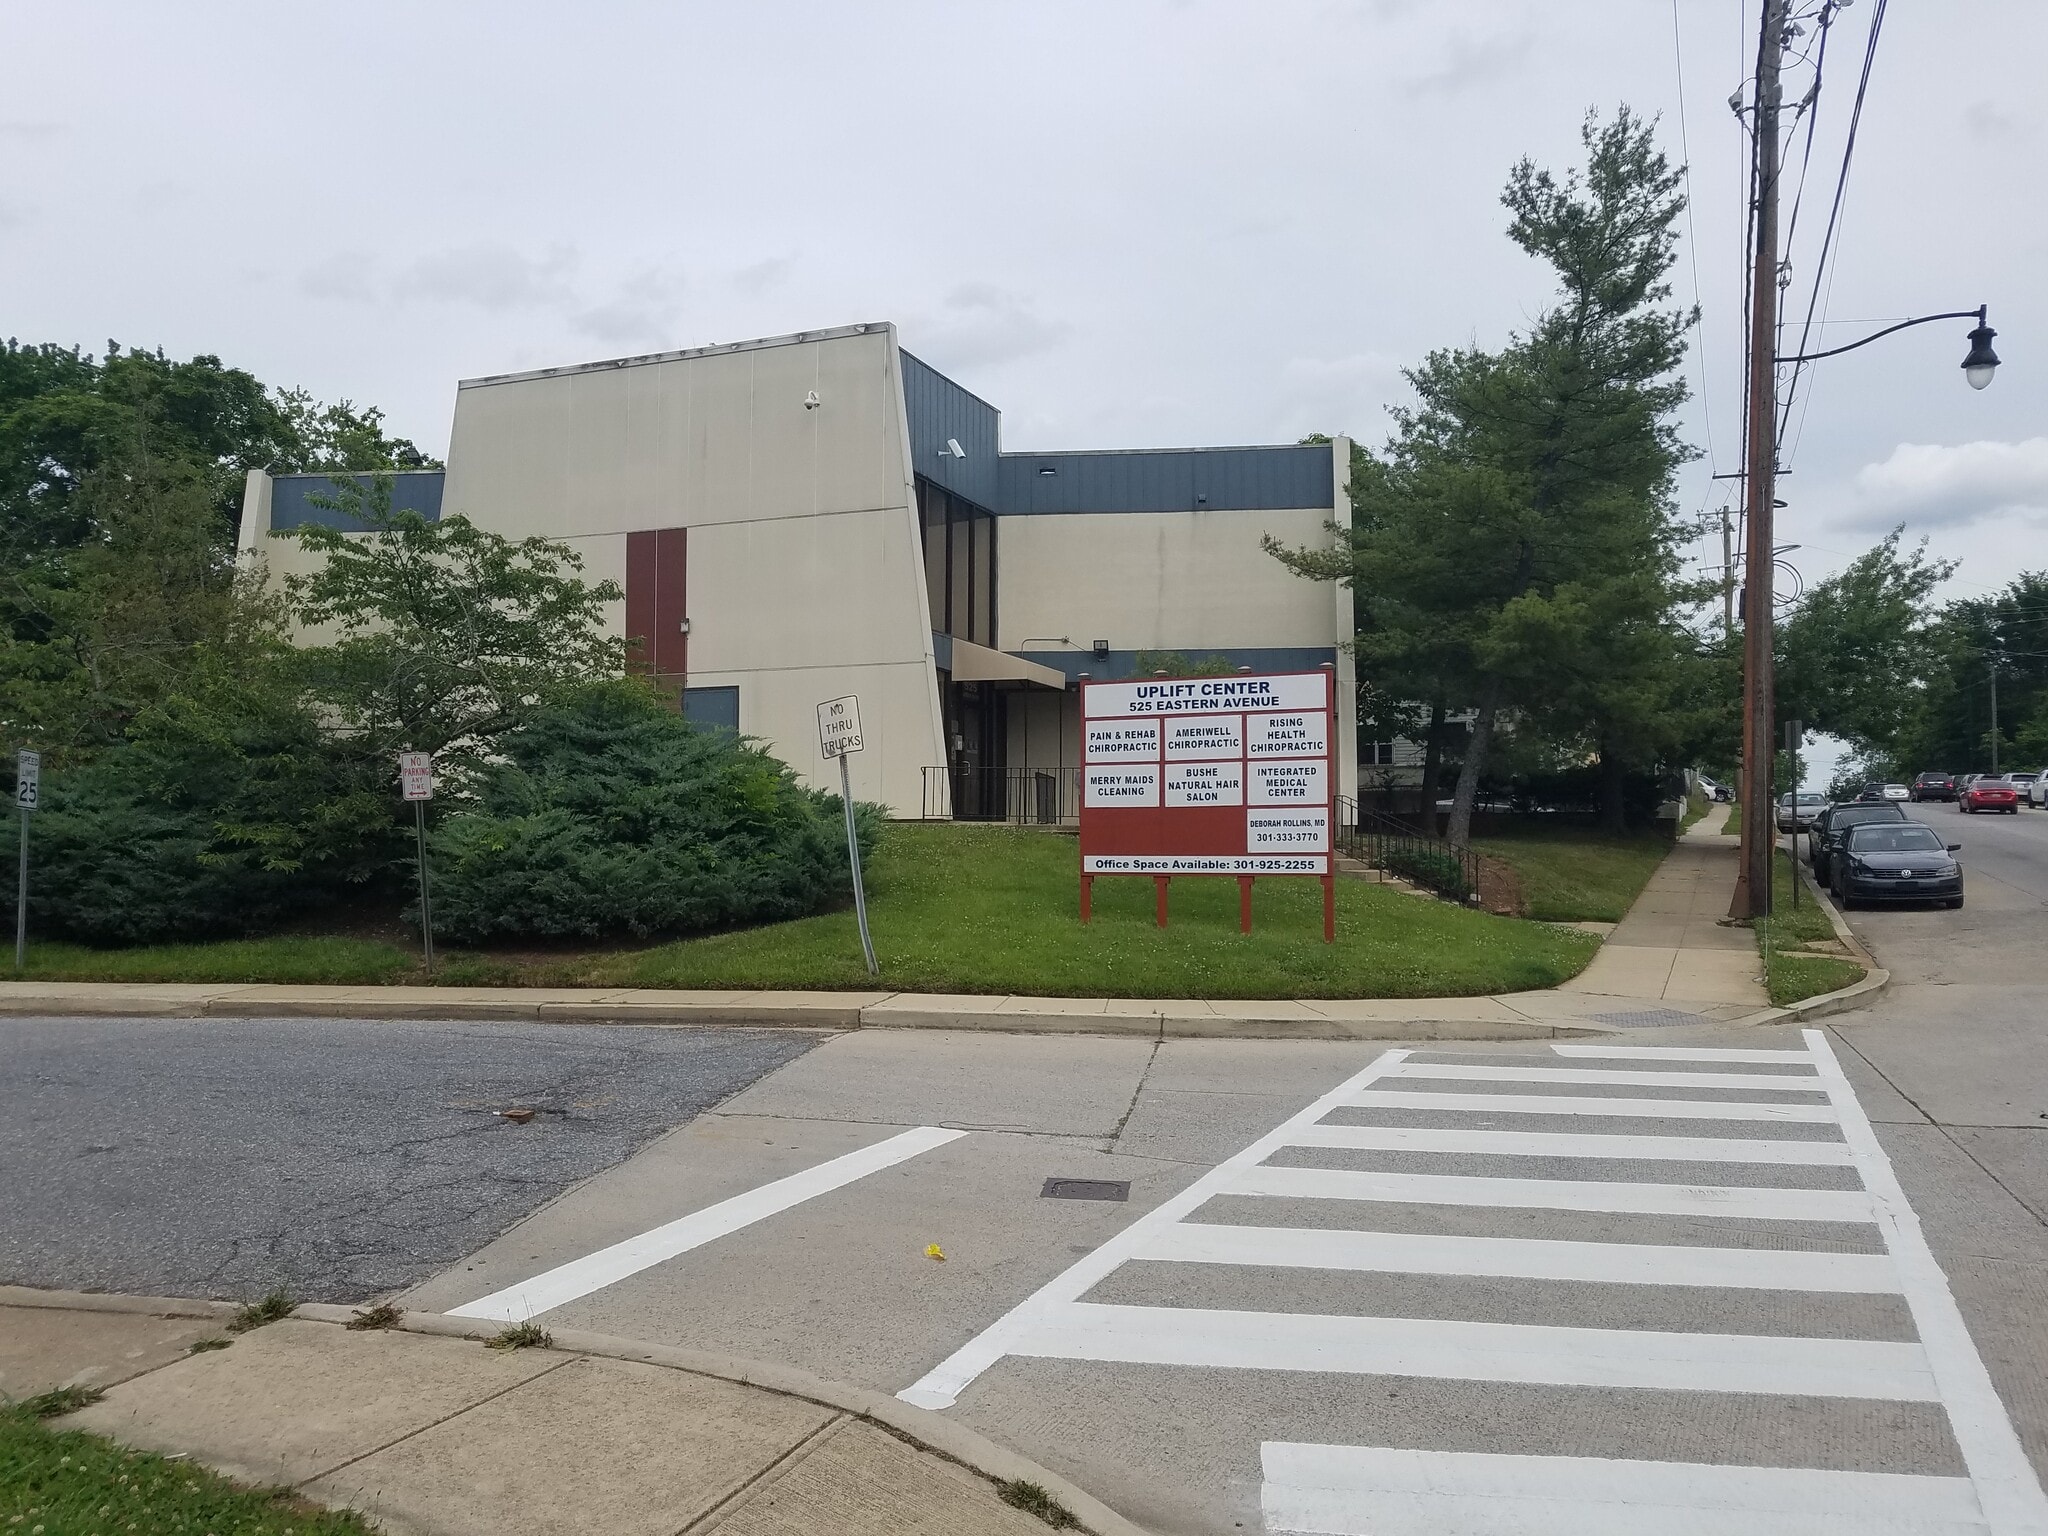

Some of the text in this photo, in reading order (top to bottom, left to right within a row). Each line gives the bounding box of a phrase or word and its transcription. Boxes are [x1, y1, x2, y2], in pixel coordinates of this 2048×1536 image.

[1137, 681, 1270, 698] UPLIFT CENTER
[1129, 696, 1280, 712] 525 EASTERN AVENUE
[830, 704, 844, 717] NO
[826, 719, 853, 735] THRU
[1269, 718, 1303, 728] RISING
[1090, 729, 1156, 741] PAIN & REHAB
[1175, 727, 1231, 738] AMERIWELL
[1267, 730, 1306, 740] HEALTH
[824, 726, 860, 752] TRUCKS
[1168, 739, 1240, 749] CHIROPRACTIC
[1088, 742, 1157, 753] CHIROPRACTIC
[1250, 741, 1324, 752] CHIROPRACTIC
[411, 756, 421, 766] NO
[404, 767, 429, 776] PARKING
[1186, 768, 1218, 777] BUSHE
[1257, 767, 1317, 777] INTEGRATED
[1090, 775, 1154, 785] MERRY MAIDS
[1168, 780, 1240, 790] NATURAL HAIR
[1266, 778, 1308, 787] MEDICAL
[20, 781, 36, 803] 25
[1098, 787, 1145, 796] CLEANING
[1186, 792, 1218, 801] SALON
[1268, 788, 1306, 797] CENTER
[1250, 819, 1325, 828] DEBORAH ROLLINS, MD
[1095, 859, 1315, 871] Office Space Available: 301-925-2255
